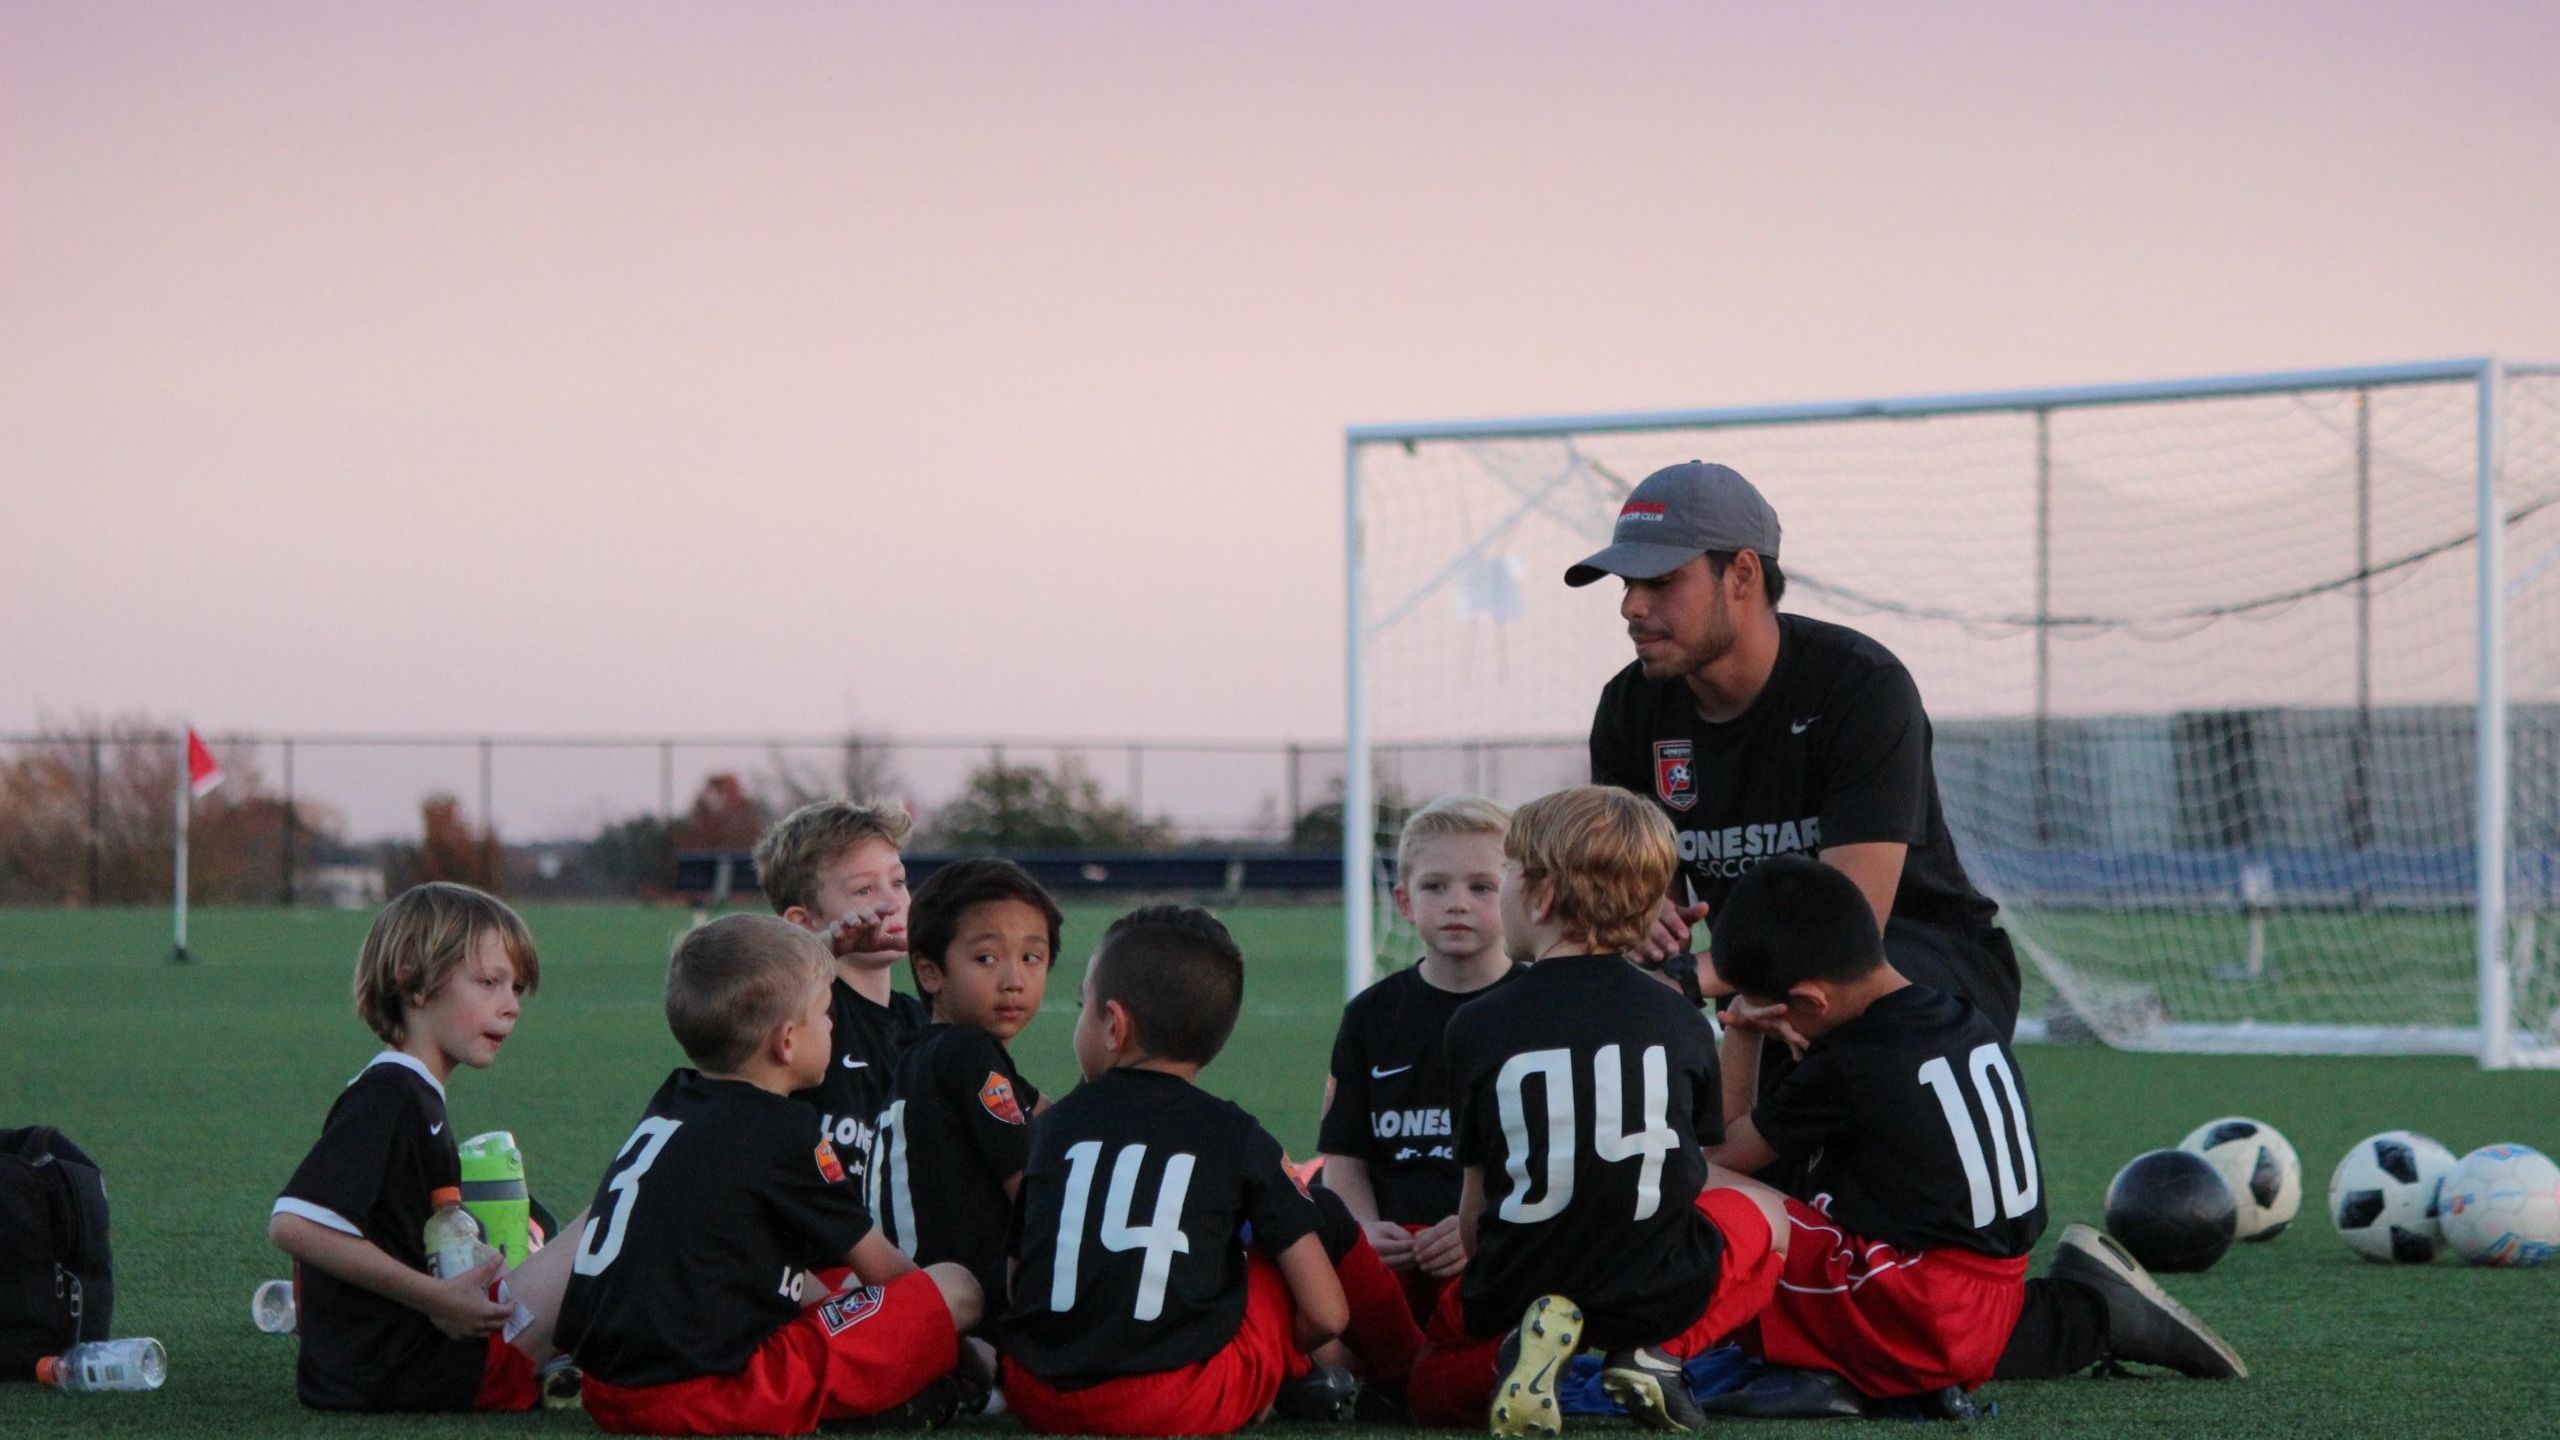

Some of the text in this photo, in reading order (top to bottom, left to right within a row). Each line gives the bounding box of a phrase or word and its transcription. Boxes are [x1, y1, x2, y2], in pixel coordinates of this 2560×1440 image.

[1676, 817, 1822, 862] ONESTAR
[573, 1115, 683, 1277] 3
[1496, 1043, 1681, 1224] 04
[1918, 1042, 2039, 1229] 10
[1051, 1140, 1197, 1322] 14
